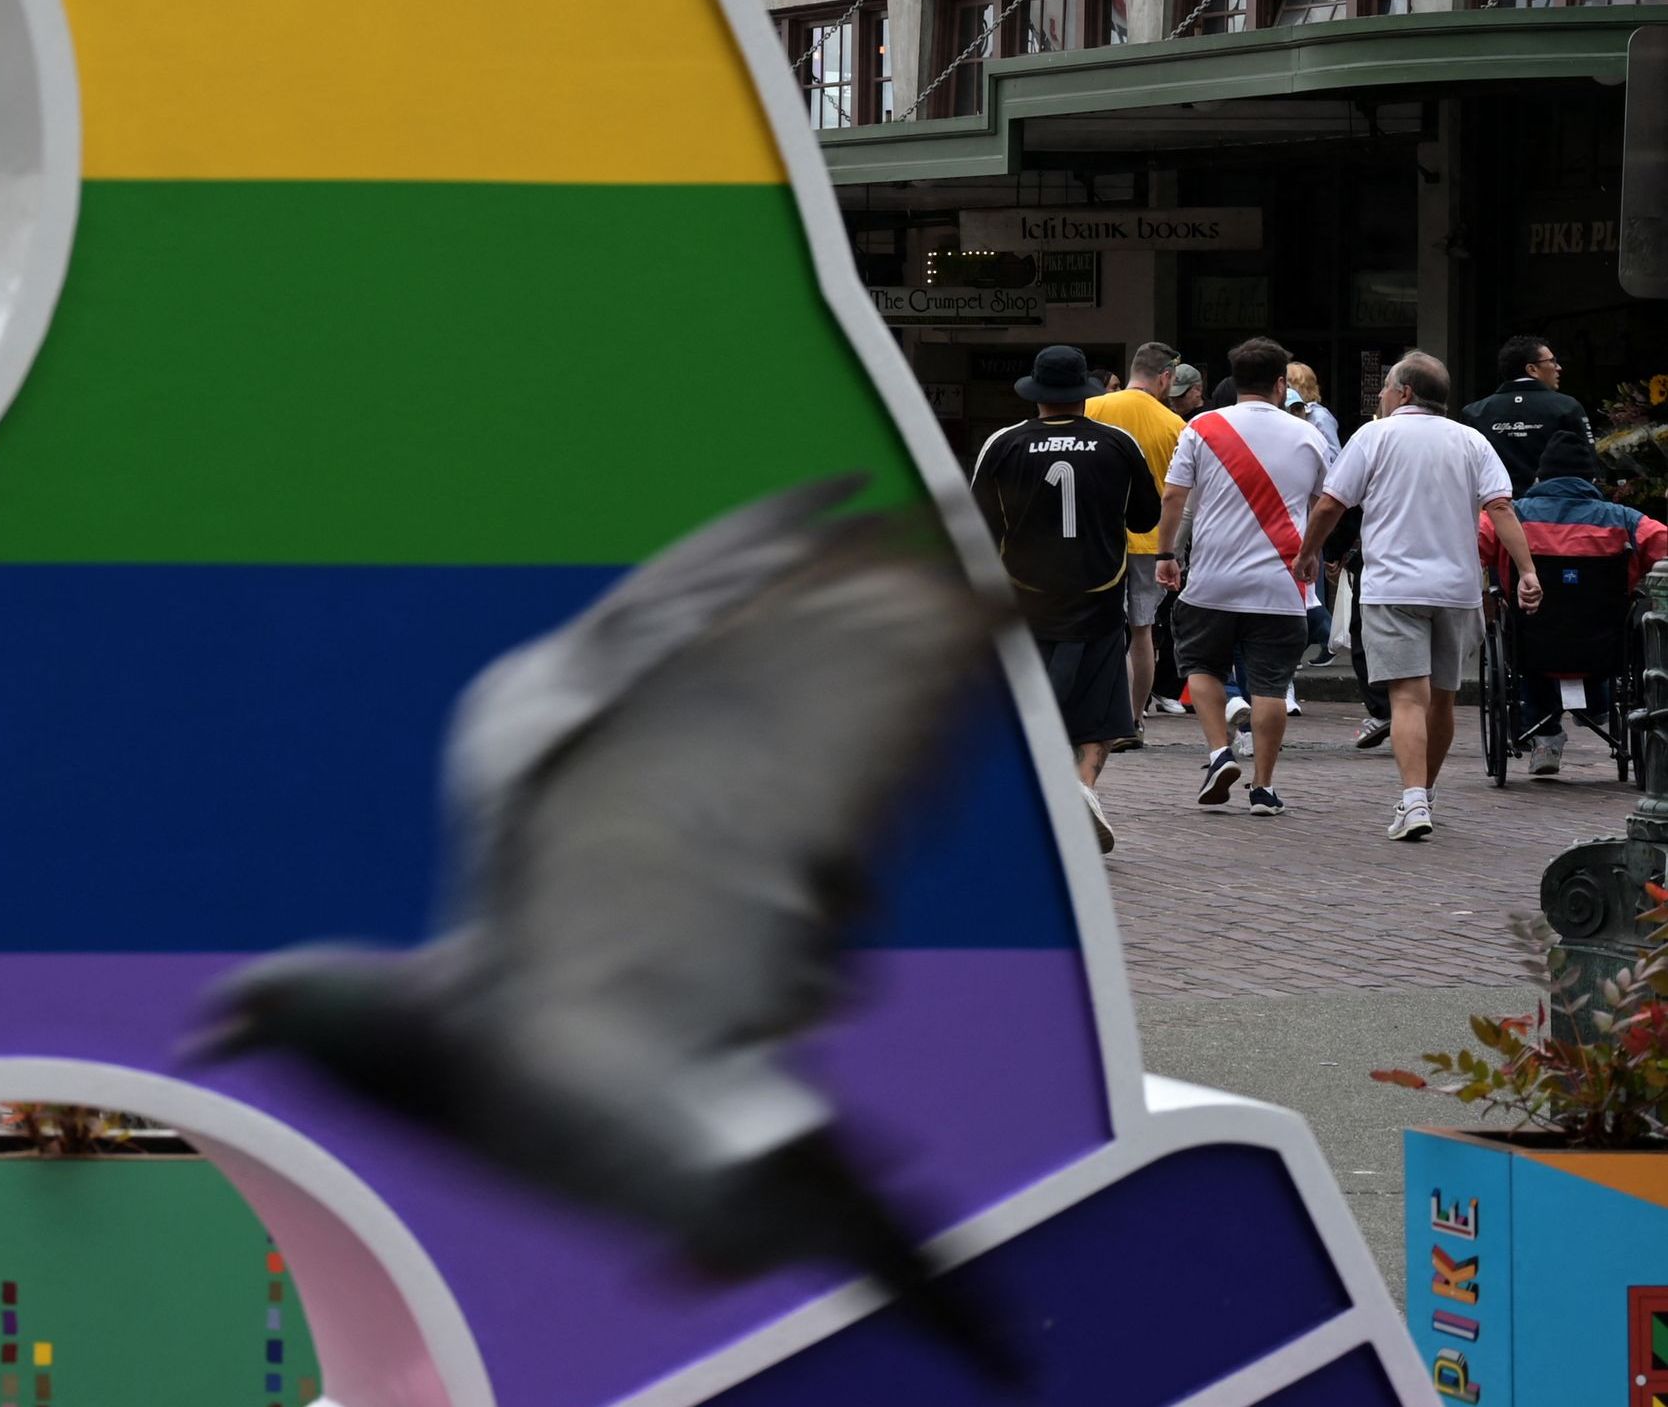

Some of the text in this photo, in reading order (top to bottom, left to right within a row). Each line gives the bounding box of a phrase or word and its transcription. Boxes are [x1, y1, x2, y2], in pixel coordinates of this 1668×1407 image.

[1062, 217, 1128, 239] bank
[1138, 217, 1219, 239] books
[1529, 221, 1584, 255] PIKE
[871, 289, 1037, 317] The Crumpet Shop
[1029, 437, 1098, 453] LUBRAX
[1045, 461, 1076, 537] 1
[1431, 1187, 1480, 1405] PIKE
